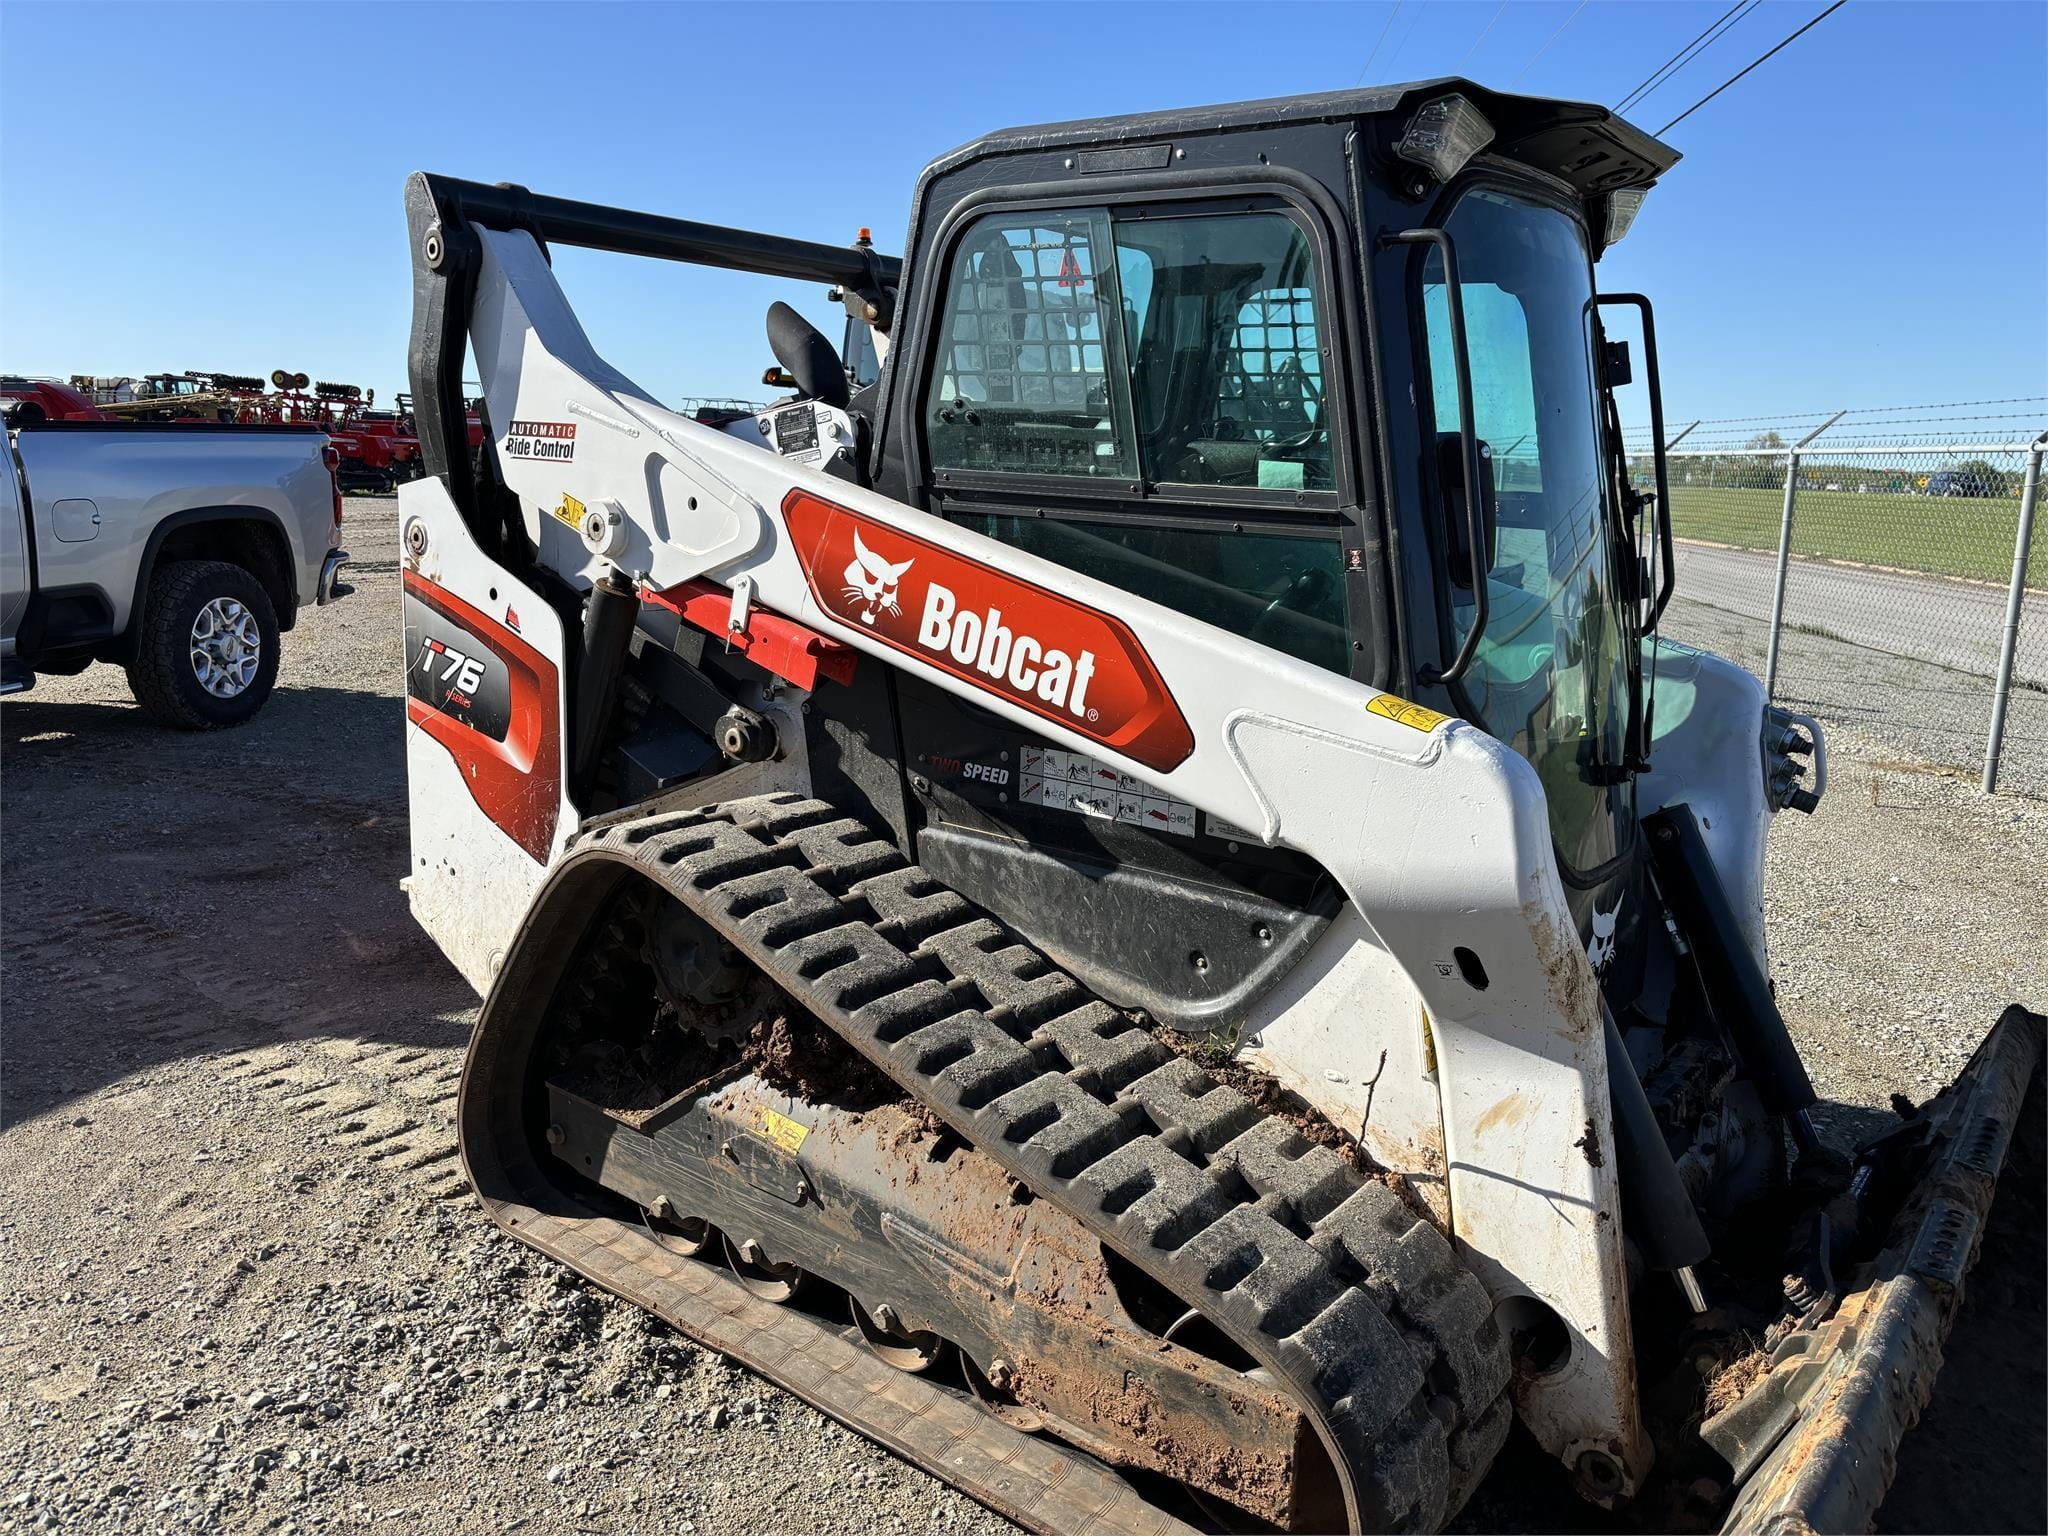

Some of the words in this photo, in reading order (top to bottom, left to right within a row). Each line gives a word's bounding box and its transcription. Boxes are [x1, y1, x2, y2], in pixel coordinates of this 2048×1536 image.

[510, 423, 574, 438] AUTOMATIC
[533, 438, 575, 459] Control
[918, 581, 1096, 718] Bobcat
[422, 636, 487, 695] T76
[962, 762, 1010, 785] SPEED
